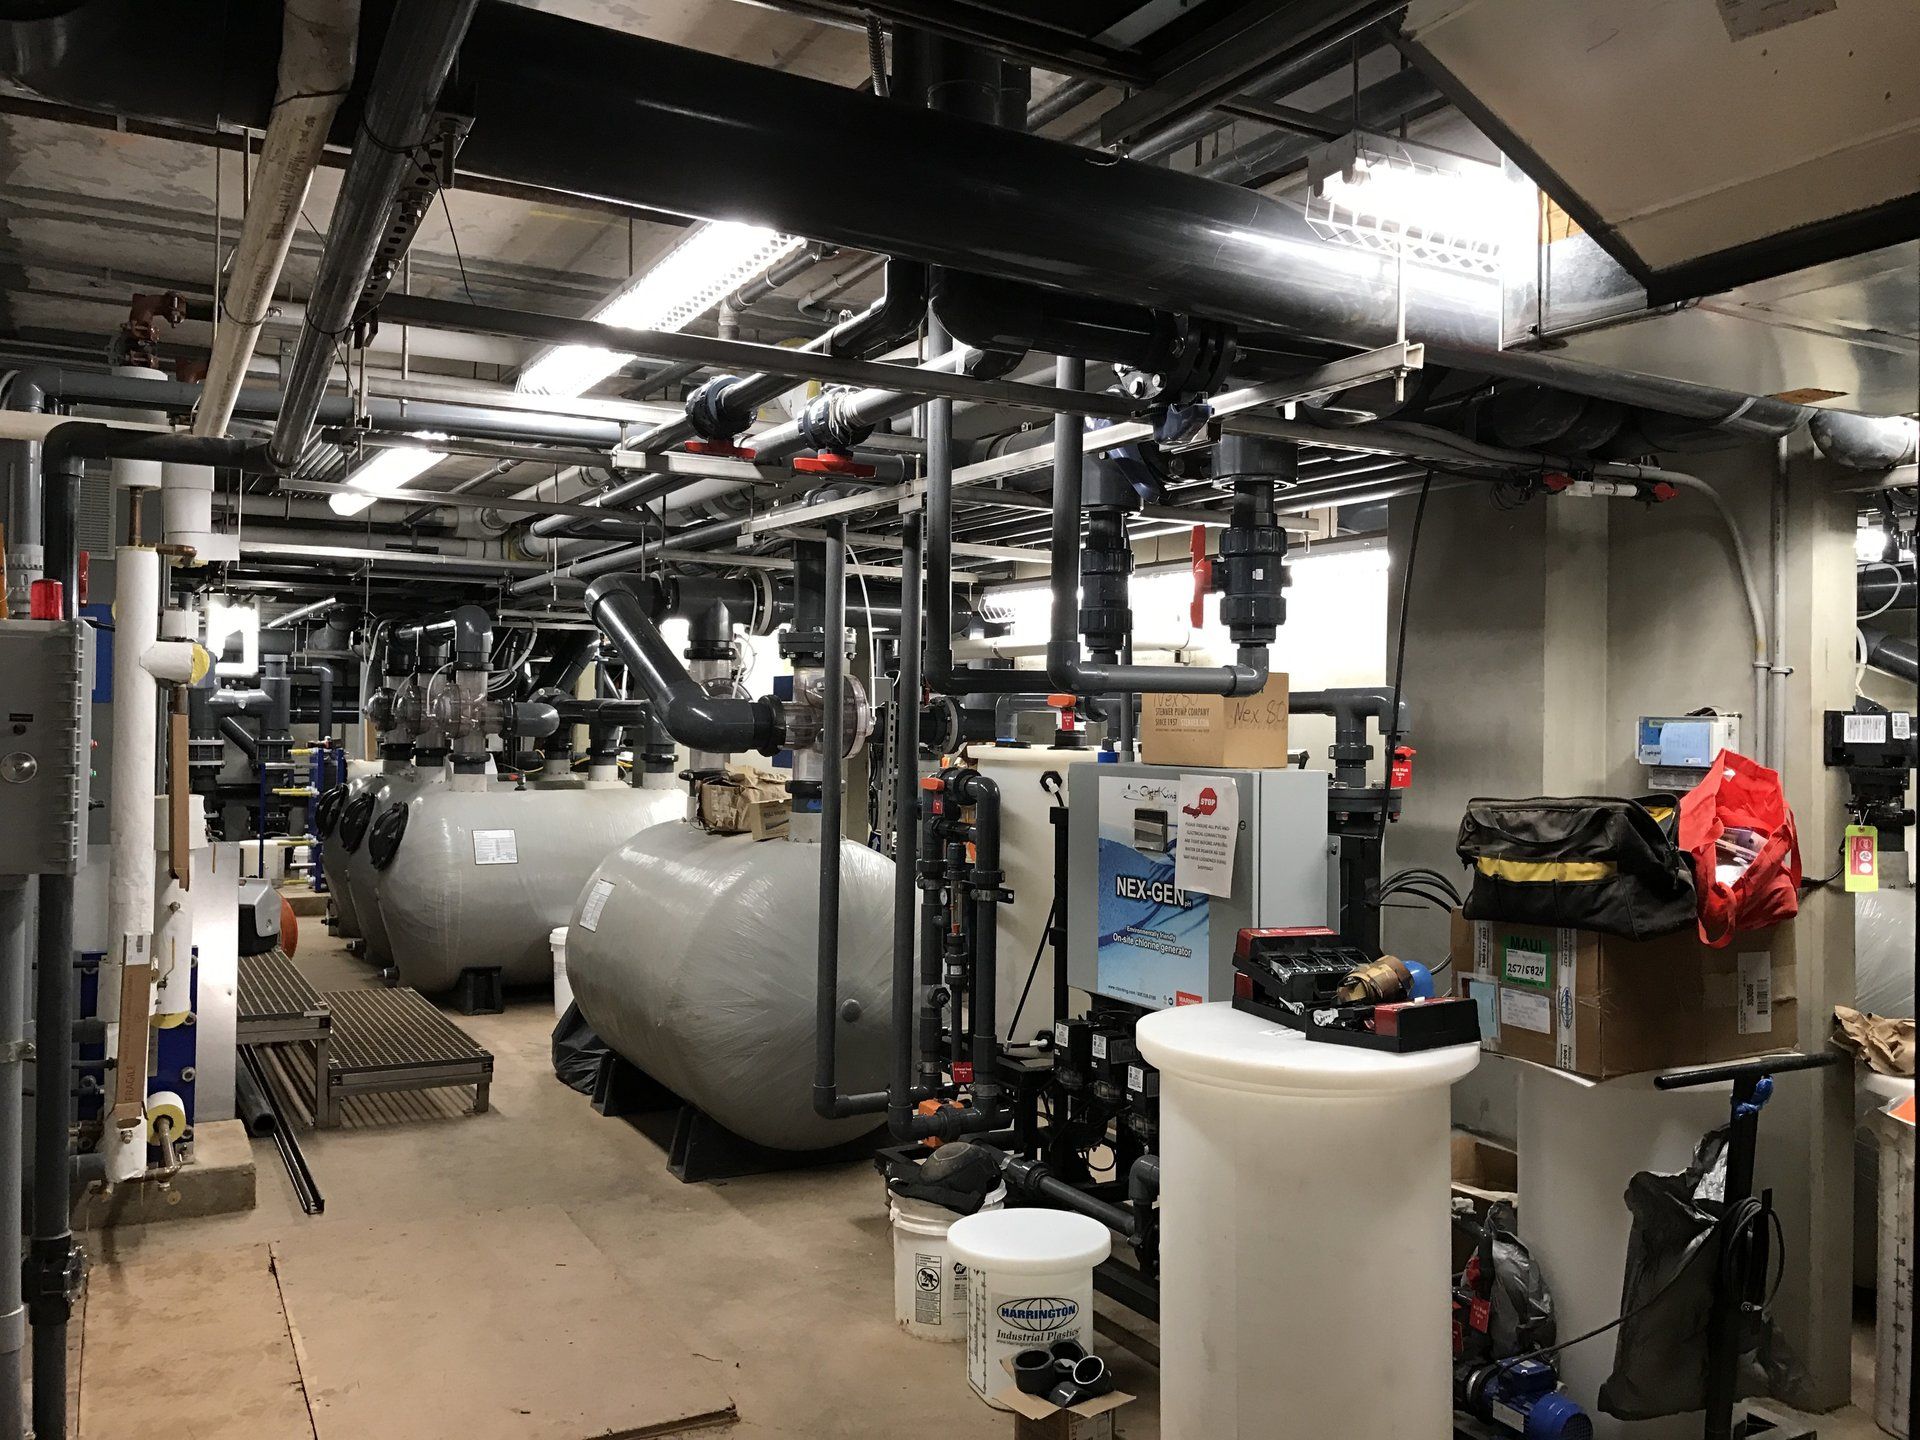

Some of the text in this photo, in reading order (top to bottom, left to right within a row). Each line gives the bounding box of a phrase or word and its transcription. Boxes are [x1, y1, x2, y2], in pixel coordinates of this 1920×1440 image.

[1155, 707, 1210, 717] STENNER PUMP COMPANY
[1233, 701, 1260, 725] Nex
[1155, 718, 1167, 726] SINCE
[1167, 718, 1178, 726] 1957
[1200, 798, 1216, 806] STOP
[1116, 877, 1184, 906] NEX-GEN
[1126, 925, 1177, 942] Environmentally friendly
[1112, 932, 1193, 958] On-site chlorine generator
[1509, 935, 1543, 953] MAUI
[123, 1064, 137, 1102] FRAGILE
[1002, 1305, 1075, 1319] HARRINGTON
[996, 1329, 1045, 1342] Industrial
